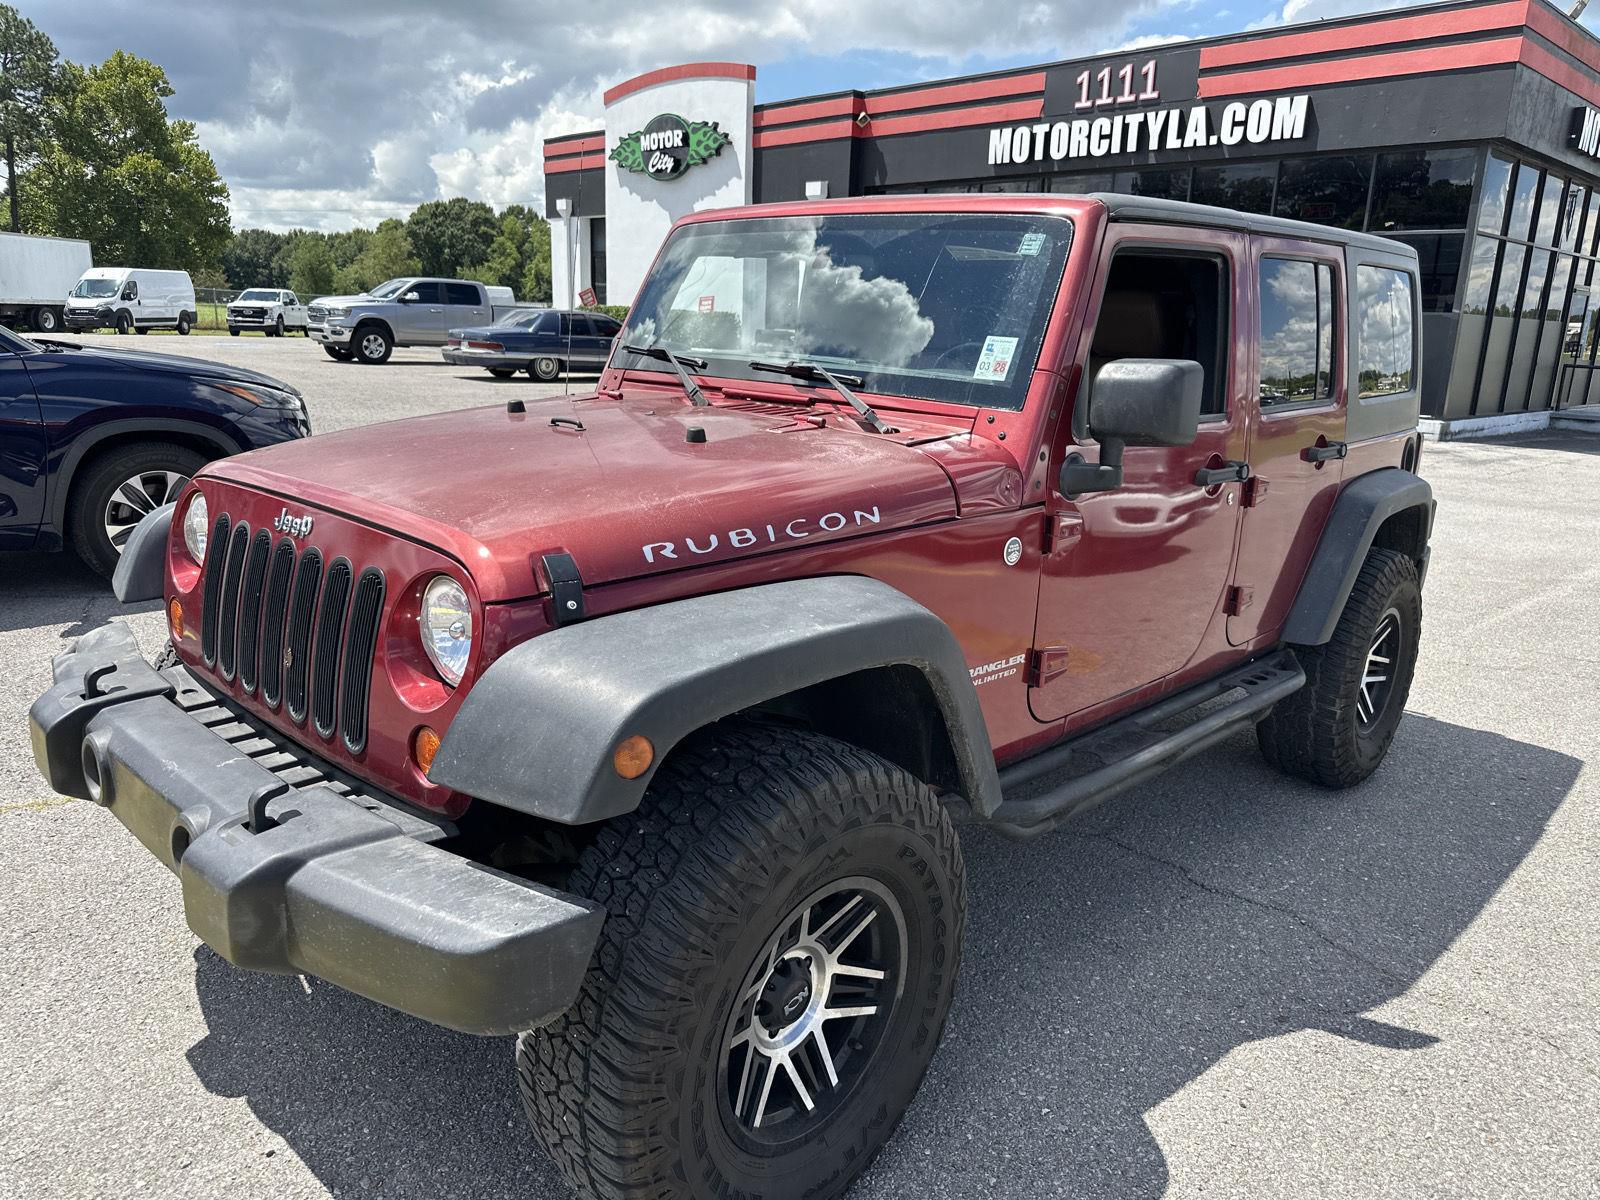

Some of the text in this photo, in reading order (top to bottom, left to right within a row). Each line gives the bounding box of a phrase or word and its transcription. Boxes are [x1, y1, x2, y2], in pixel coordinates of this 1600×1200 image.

[1074, 59, 1160, 109] 1111
[640, 129, 683, 151] MOTOR
[988, 94, 1309, 165] MOTORCITYLA.COM
[1578, 106, 1600, 158] MO
[648, 152, 675, 173] City
[979, 361, 991, 371] 03
[274, 507, 313, 539] Jeep
[642, 506, 881, 563] RUBICON
[968, 653, 1025, 678] RANGLER
[972, 668, 1017, 686] NLIMITED
[898, 845, 946, 1053] PATAGONIA
[784, 986, 809, 1017] ION
